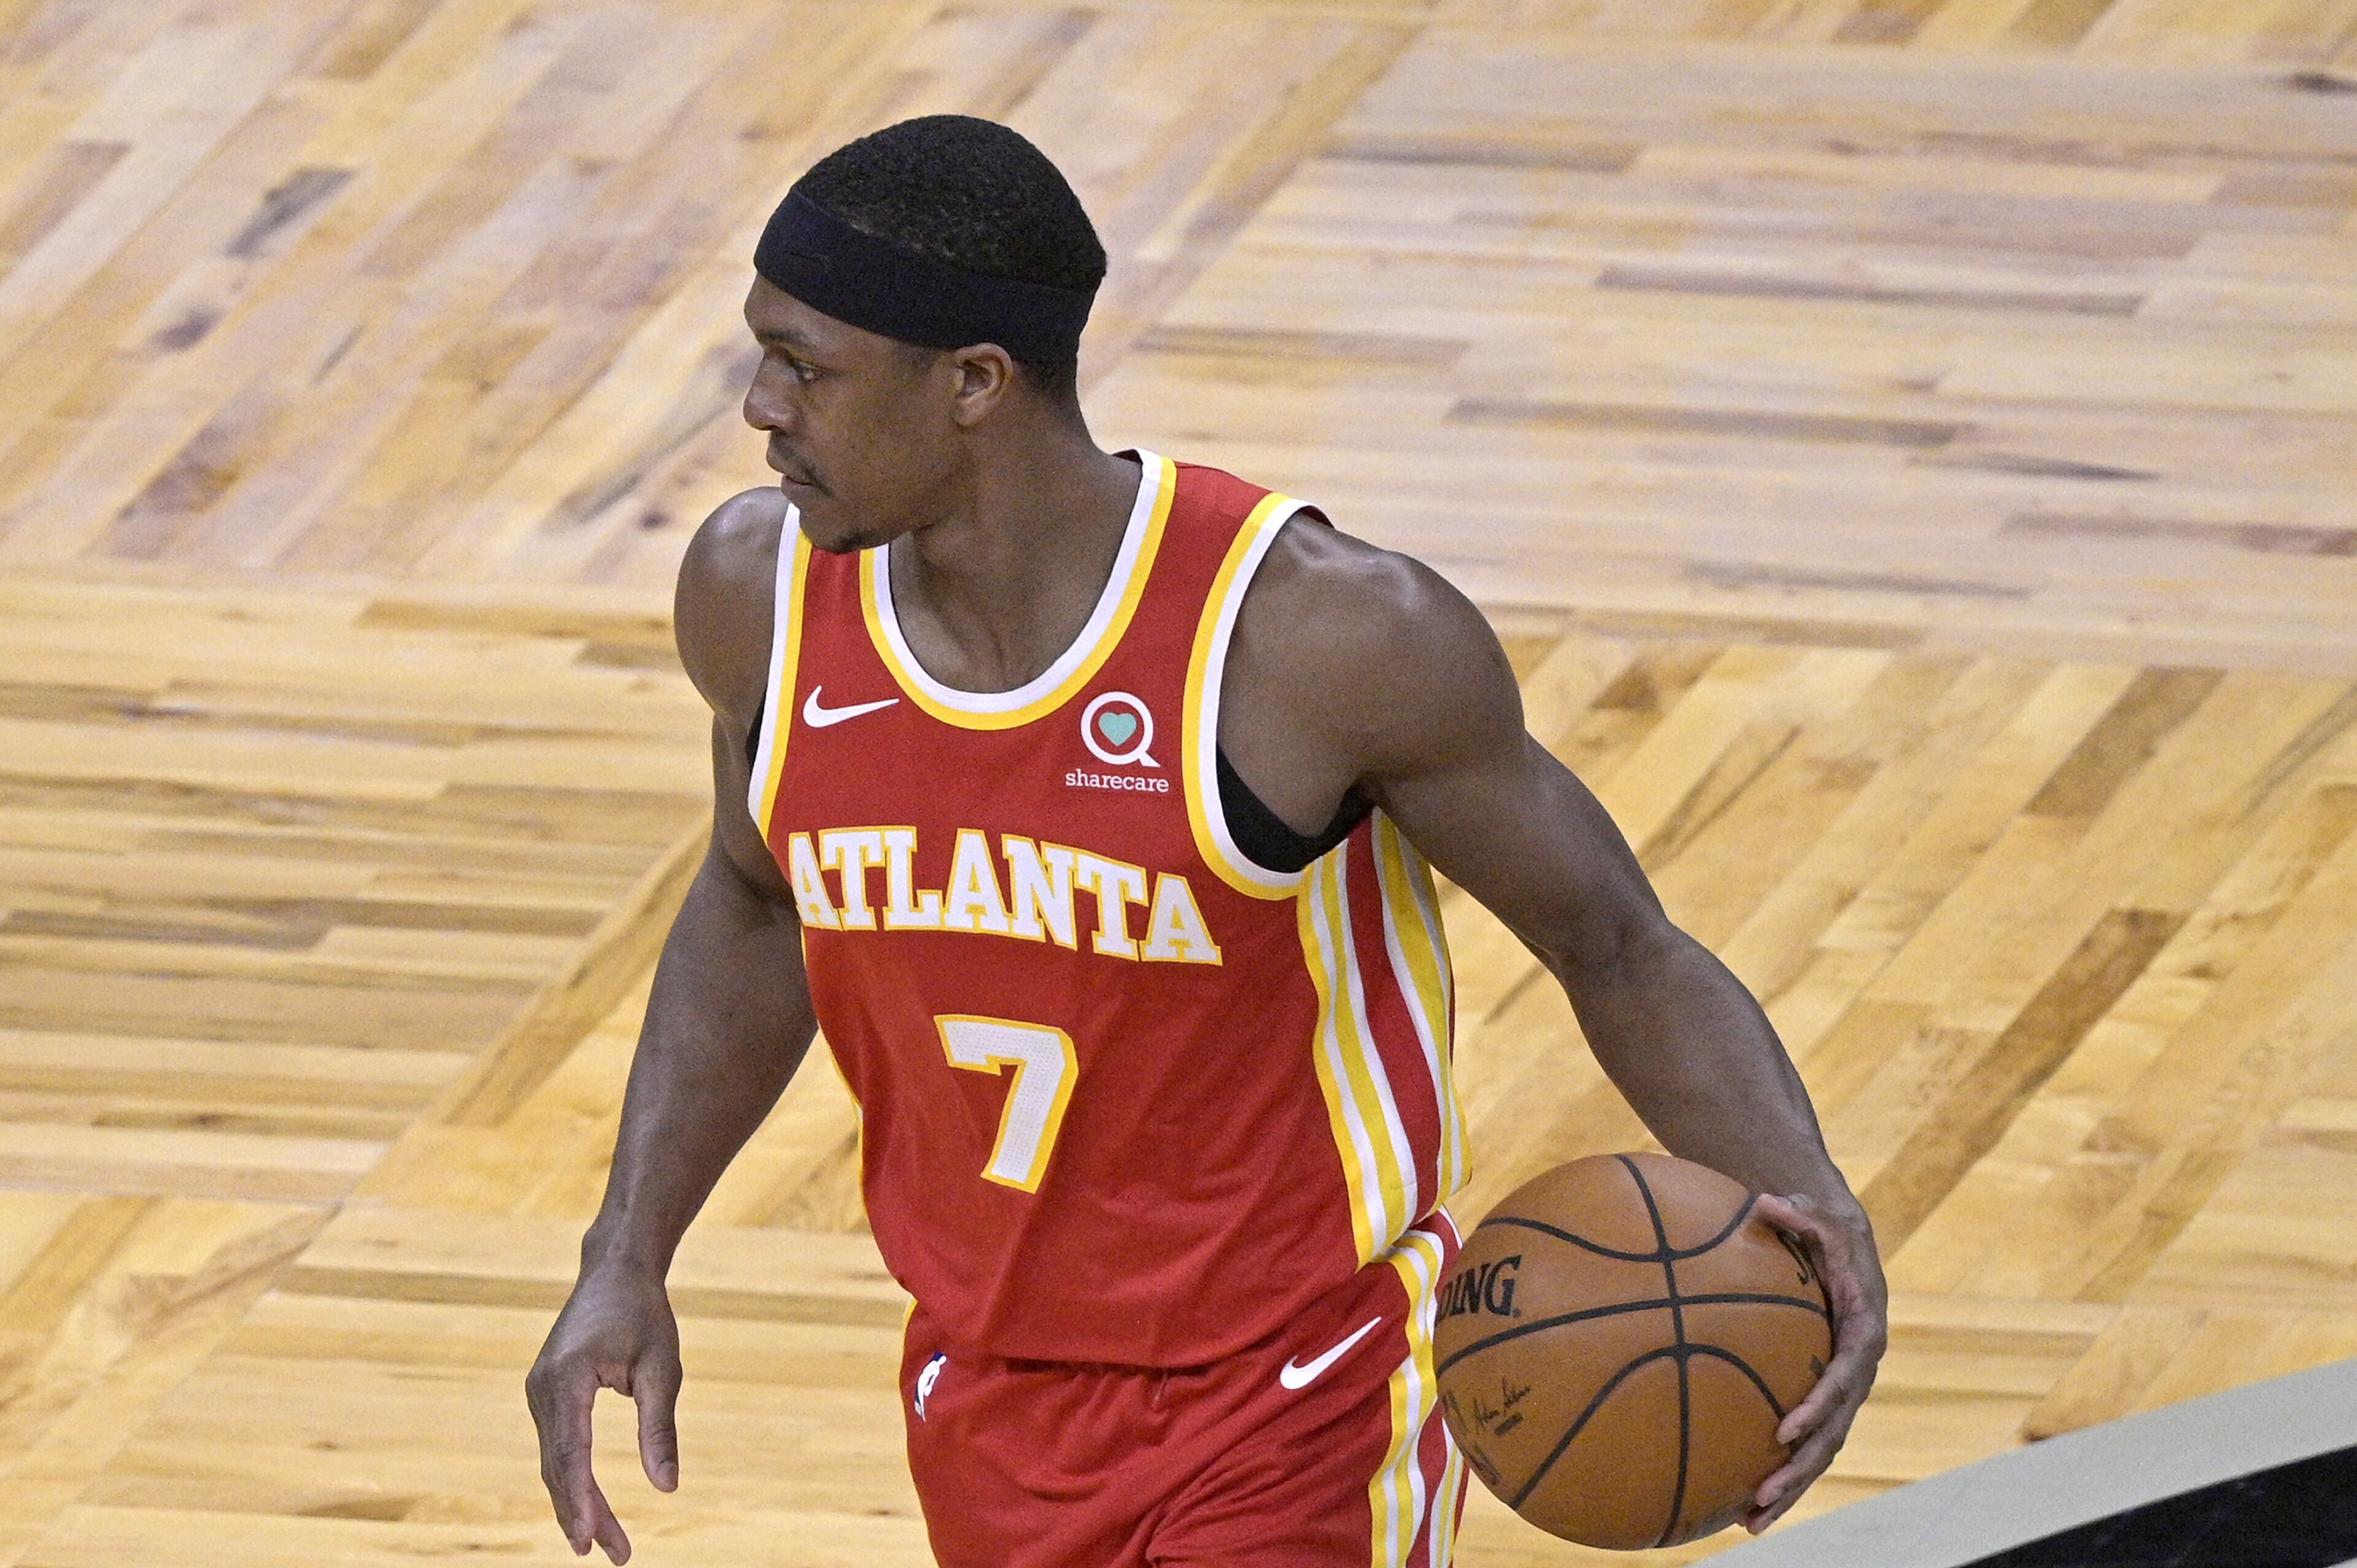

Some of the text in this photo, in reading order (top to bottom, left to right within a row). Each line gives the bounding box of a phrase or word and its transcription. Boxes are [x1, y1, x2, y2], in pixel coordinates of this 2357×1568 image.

[1066, 768, 1169, 792] sharecare
[788, 825, 1223, 966] ATLANTA
[934, 1014, 1079, 1194] 7
